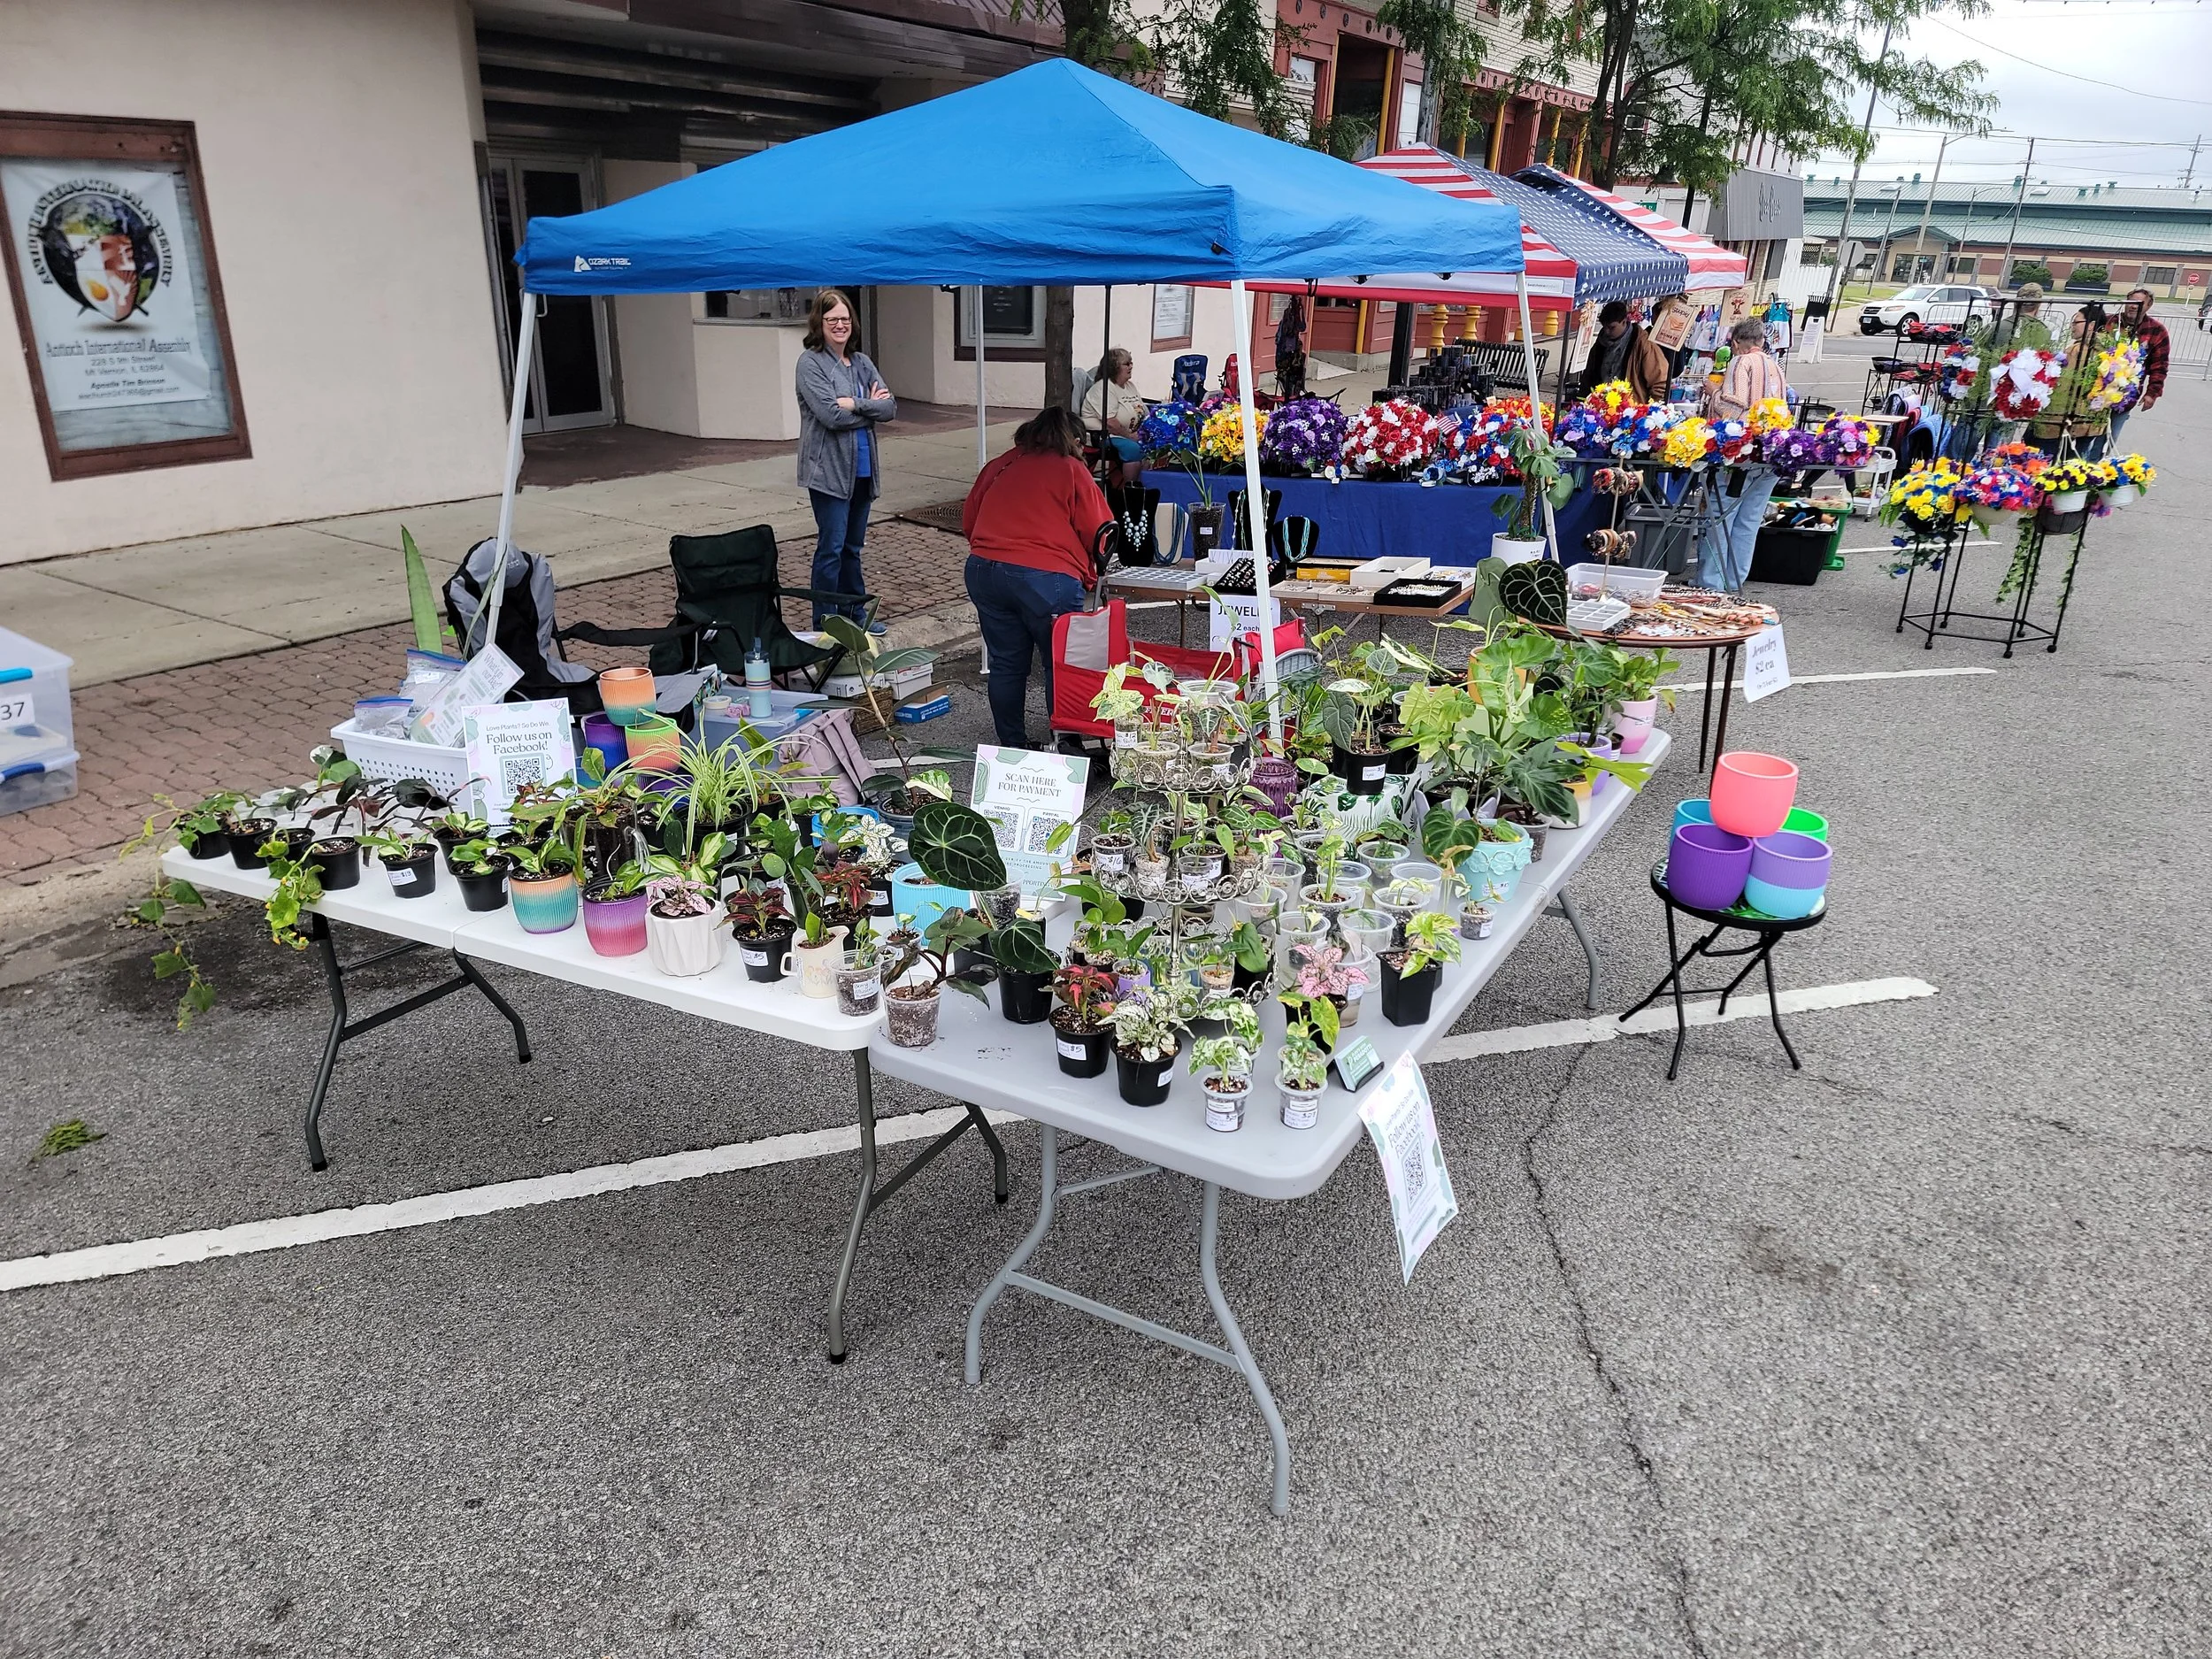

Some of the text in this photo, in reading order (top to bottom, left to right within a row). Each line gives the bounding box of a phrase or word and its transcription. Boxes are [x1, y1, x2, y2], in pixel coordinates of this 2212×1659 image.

[487, 731, 552, 745] Follow us on
[493, 741, 549, 755] Facebook!
[1005, 772, 1056, 787] SCAN HERE
[998, 782, 1062, 798] FOR PAYMENT
